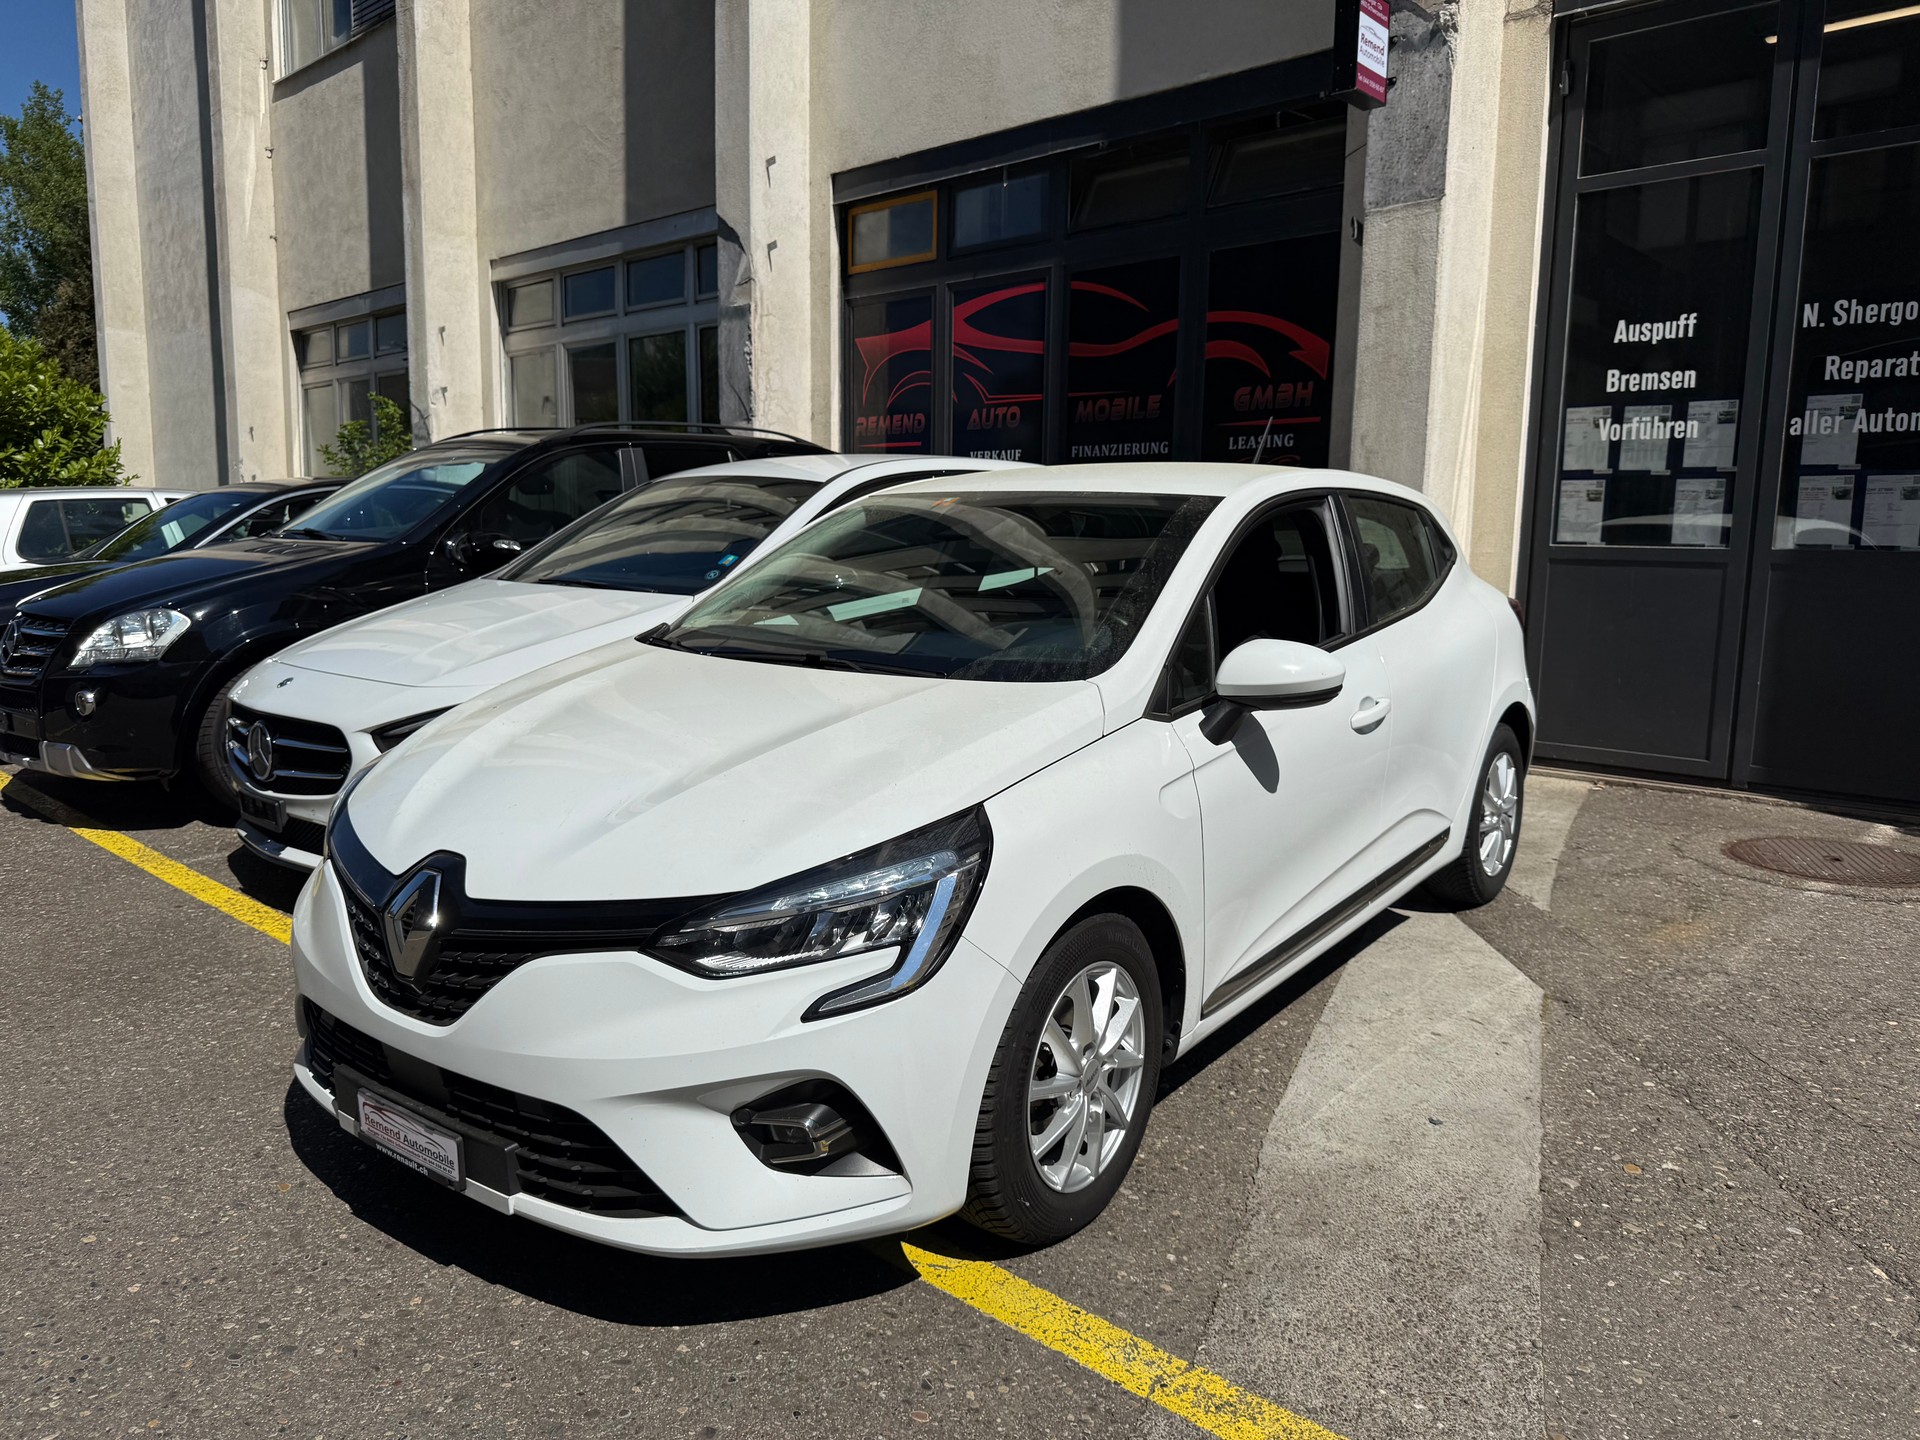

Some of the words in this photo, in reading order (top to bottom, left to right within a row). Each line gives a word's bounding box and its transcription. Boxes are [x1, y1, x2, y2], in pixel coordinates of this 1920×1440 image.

[1360, 32, 1385, 56] Remend
[1613, 312, 1698, 345] Auspuff
[1802, 303, 1826, 329] N.
[1832, 298, 1919, 327] Shergo
[1605, 368, 1697, 393] Bremsen
[1824, 350, 1920, 384] Reparat
[855, 412, 926, 437] REMEND
[965, 405, 1022, 431] AUTO
[1075, 394, 1161, 424] MOBILE
[1598, 415, 1699, 442] Vorführen
[1789, 409, 1845, 436] aller
[969, 448, 1023, 461] VERKAUF
[1071, 441, 1169, 458] FINANZIERUNG
[364, 1112, 401, 1140] Remend
[402, 1133, 455, 1168] Automobile
[375, 1142, 429, 1177] www.renault.ch
